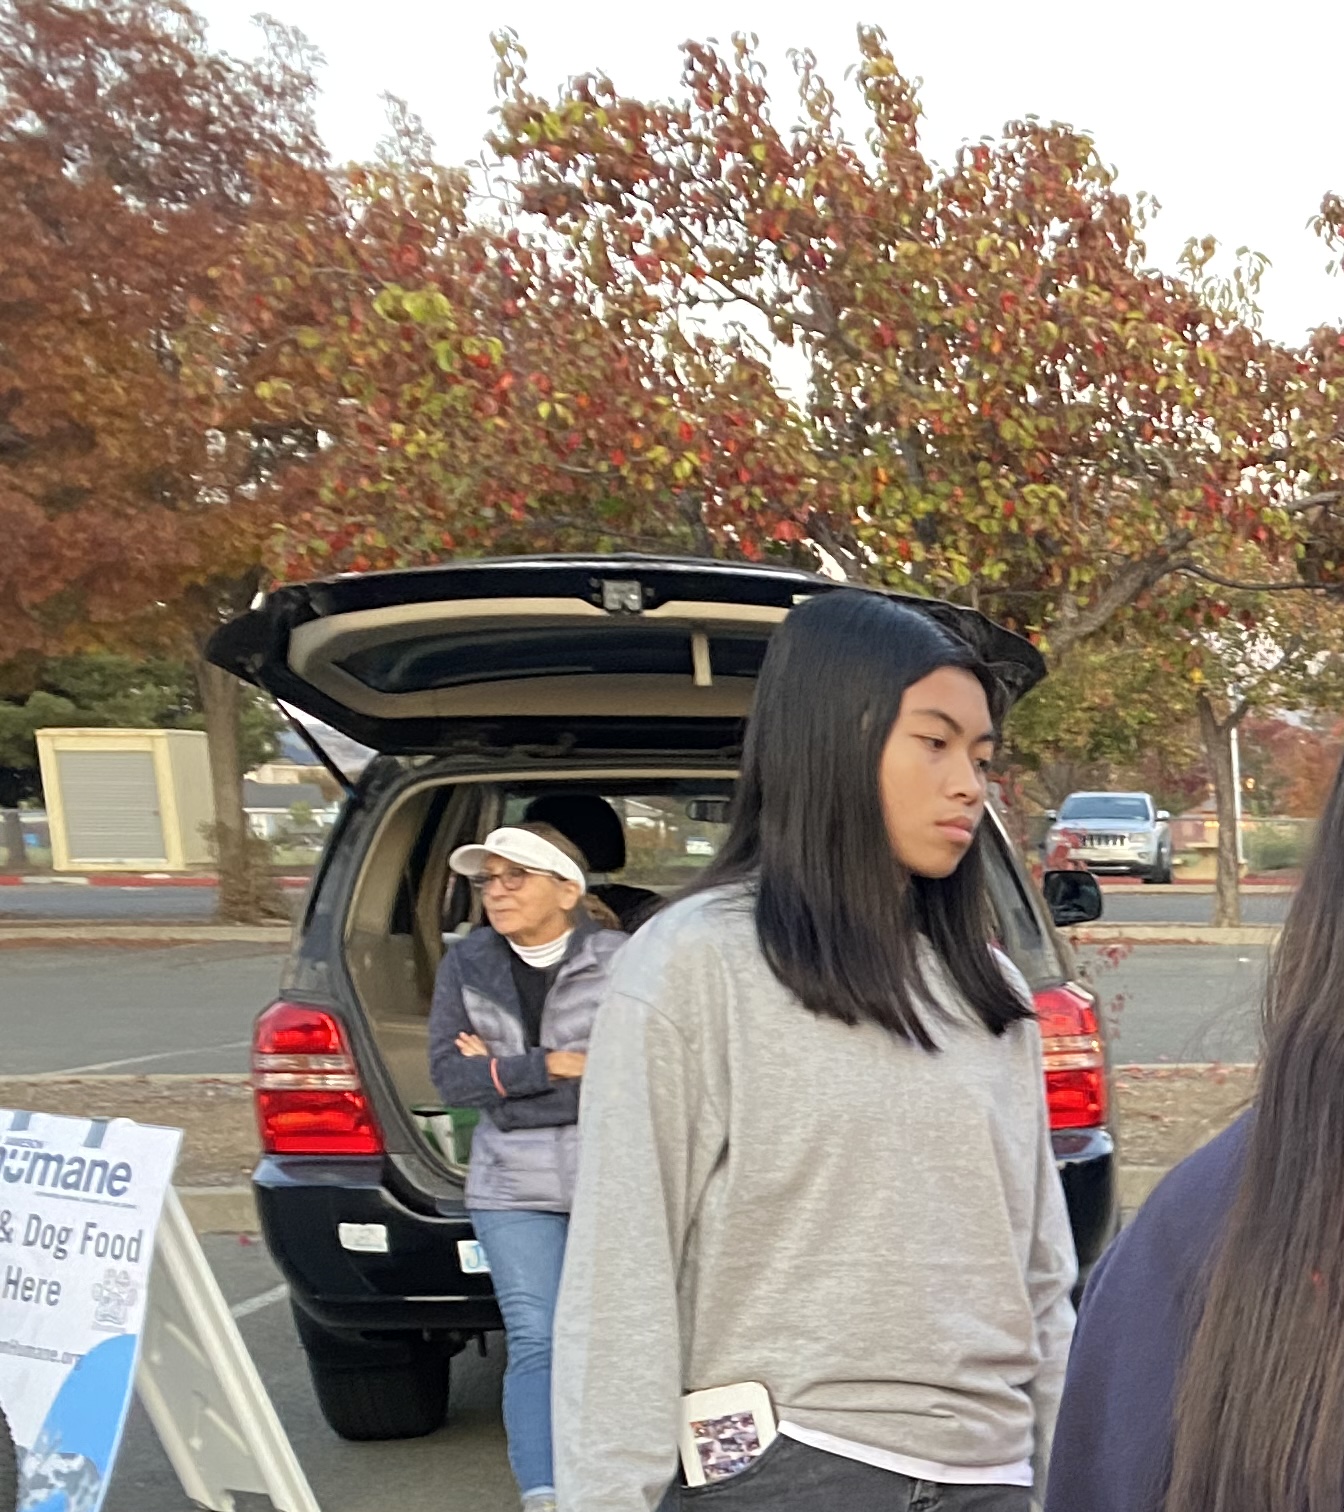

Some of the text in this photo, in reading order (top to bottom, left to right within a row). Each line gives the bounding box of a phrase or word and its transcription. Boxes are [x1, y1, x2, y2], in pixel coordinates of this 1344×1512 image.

[22, 1213, 73, 1260] Dog
[79, 1221, 144, 1263] Food
[2, 1264, 61, 1306] Here
